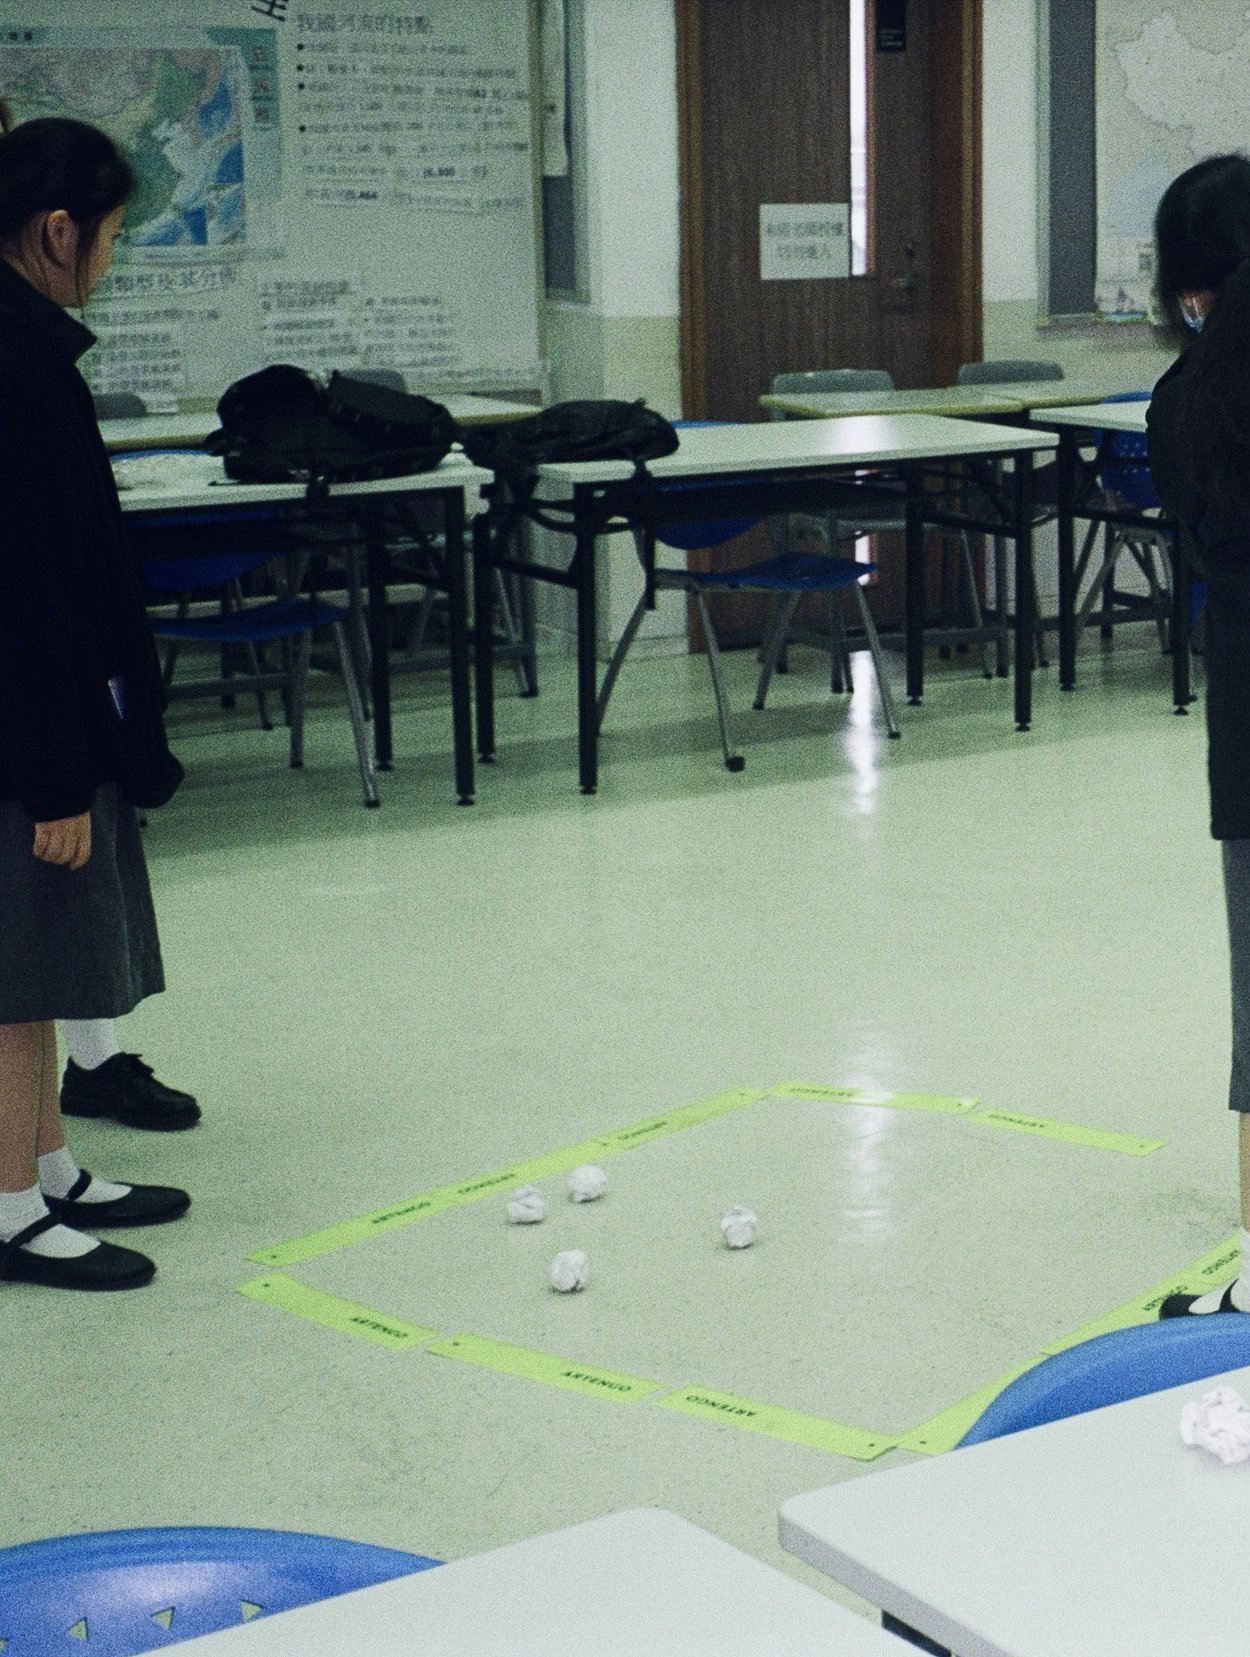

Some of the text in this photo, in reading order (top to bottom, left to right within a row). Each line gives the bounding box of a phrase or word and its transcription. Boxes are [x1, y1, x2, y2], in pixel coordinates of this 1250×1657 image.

[350, 1315, 409, 1340] ARTENGO
[561, 1370, 633, 1393] ARTENGO
[686, 1395, 756, 1417] ARTENGO
